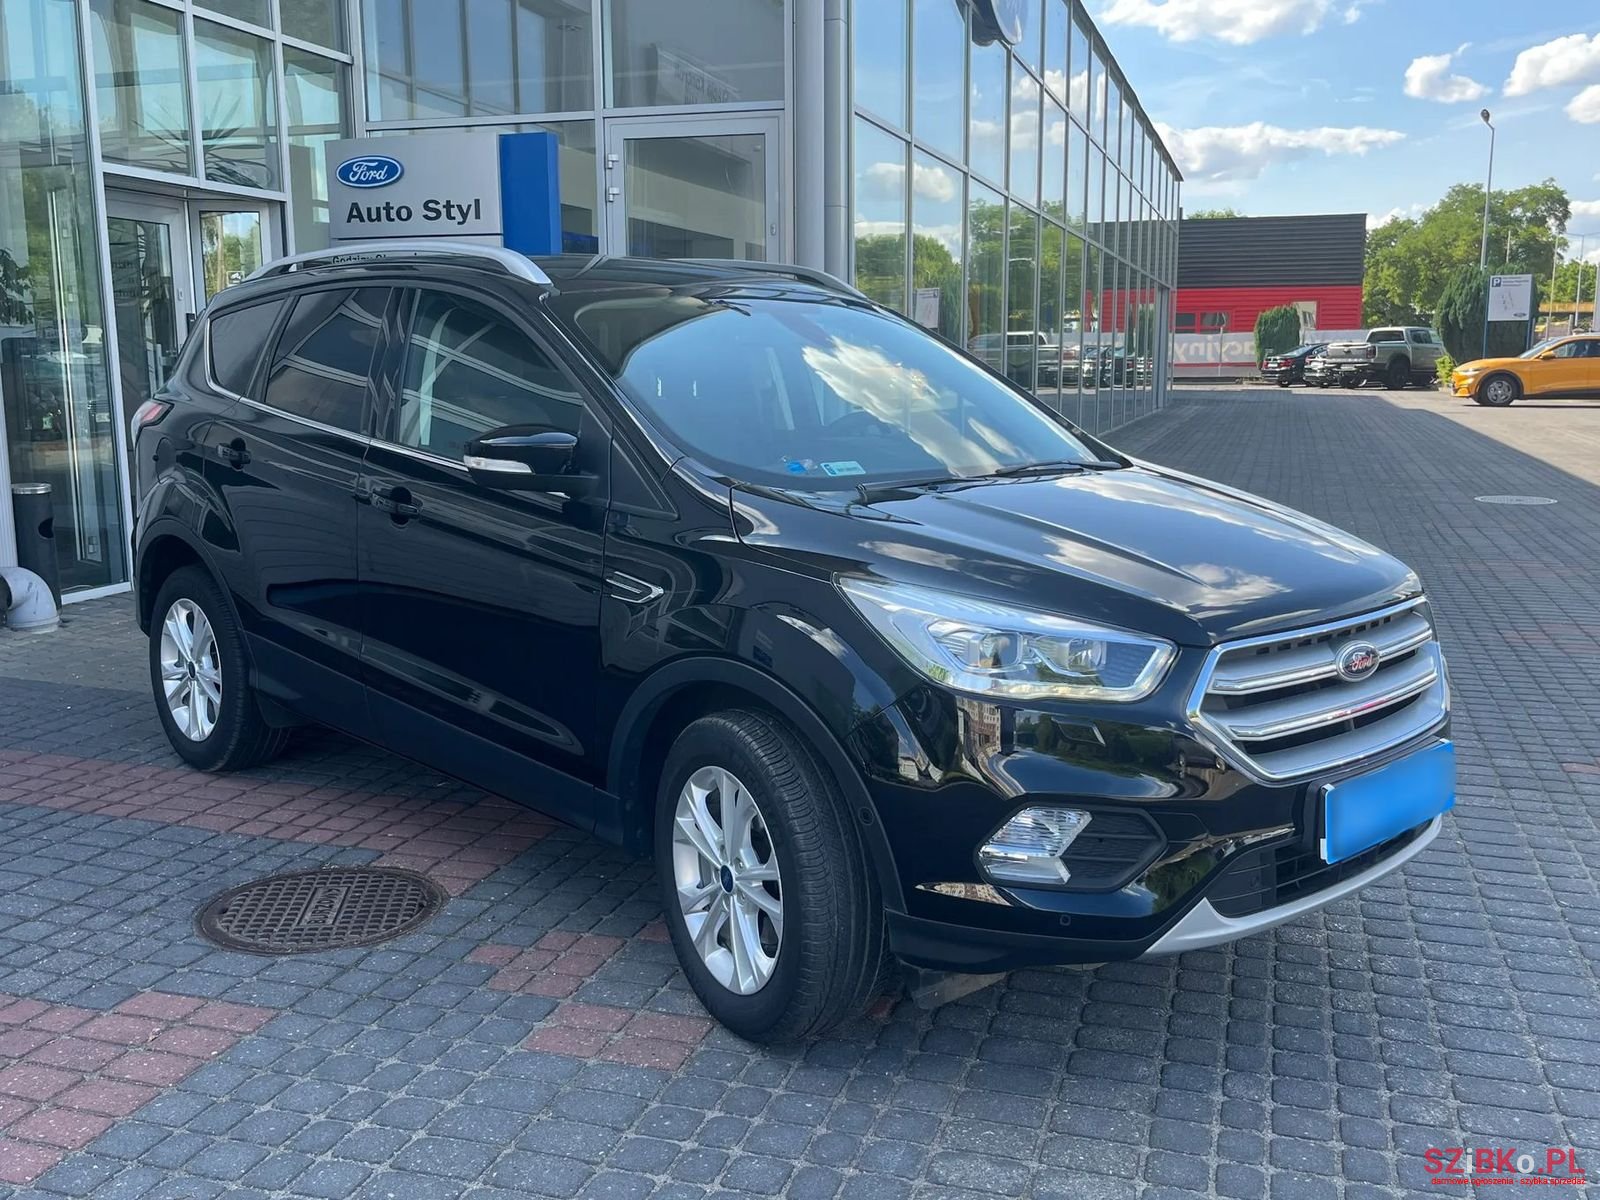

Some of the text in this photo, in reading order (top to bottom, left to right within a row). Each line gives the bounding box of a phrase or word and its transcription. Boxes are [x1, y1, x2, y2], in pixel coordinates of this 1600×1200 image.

[349, 161, 388, 182] Ford
[346, 198, 481, 226] Auto Styl
